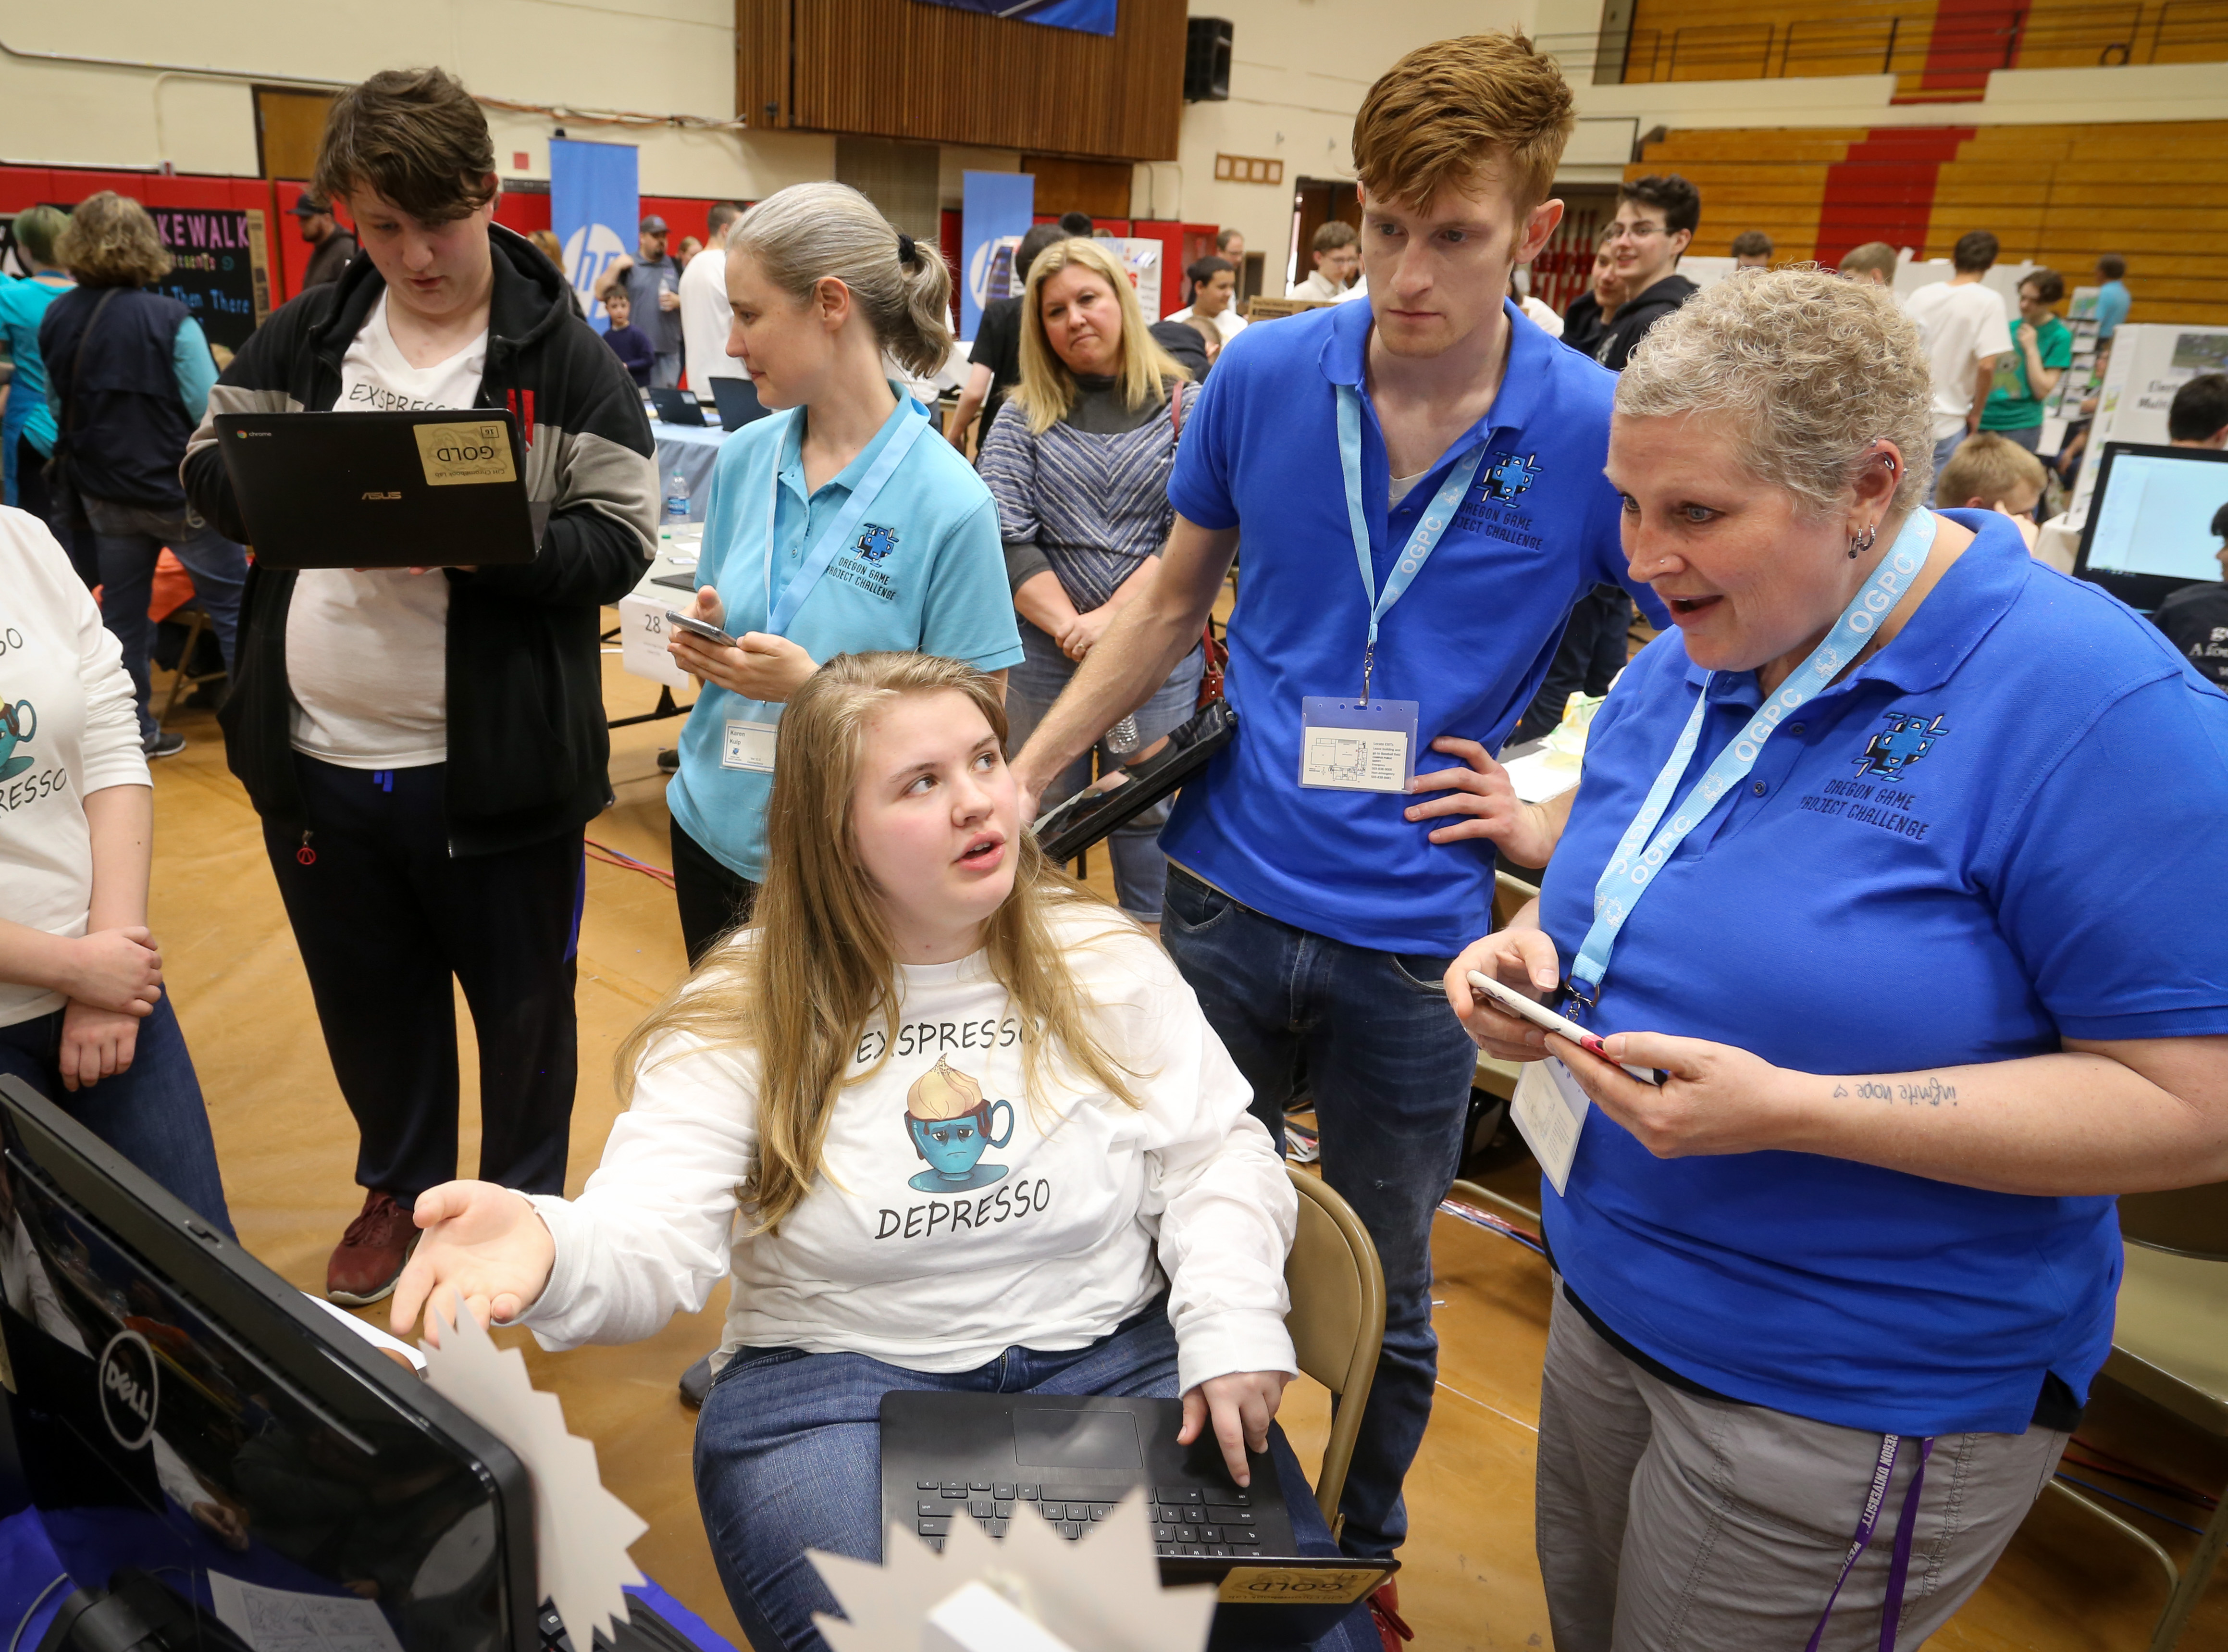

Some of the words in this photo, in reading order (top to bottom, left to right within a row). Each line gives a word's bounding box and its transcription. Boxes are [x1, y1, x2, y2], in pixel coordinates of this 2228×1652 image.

[349, 383, 458, 411] EXSPRE
[437, 446, 494, 461] GOLD
[361, 491, 401, 500] ASUS
[1460, 501, 1500, 522] OREGON
[1503, 514, 1533, 531] GAME
[1400, 516, 1442, 574] OGPC
[1485, 525, 1543, 551] CHALLENGE
[825, 565, 854, 583] PROJECT
[855, 577, 896, 600] CHALLENGE
[838, 557, 867, 575] OREGON
[868, 570, 890, 585] GAME
[1848, 553, 1916, 633] OGPC
[645, 614, 661, 633] 28
[1734, 688, 1803, 763] OGPC
[1823, 779, 1874, 800] OREGON
[1874, 789, 1916, 811] GAME
[1801, 796, 1848, 815] PROJECT
[1847, 804, 1929, 841] CHALLENGE
[1609, 806, 1659, 875] OGPC
[1629, 815, 1691, 885] OGPC
[1855, 1081, 1892, 1105] hope
[874, 1179, 1051, 1239] DEPRESSO
[106, 1359, 149, 1421] DELL
[1861, 1466, 1890, 1528] UNIVERSITY
[1248, 1583, 1343, 1591] GOLD
